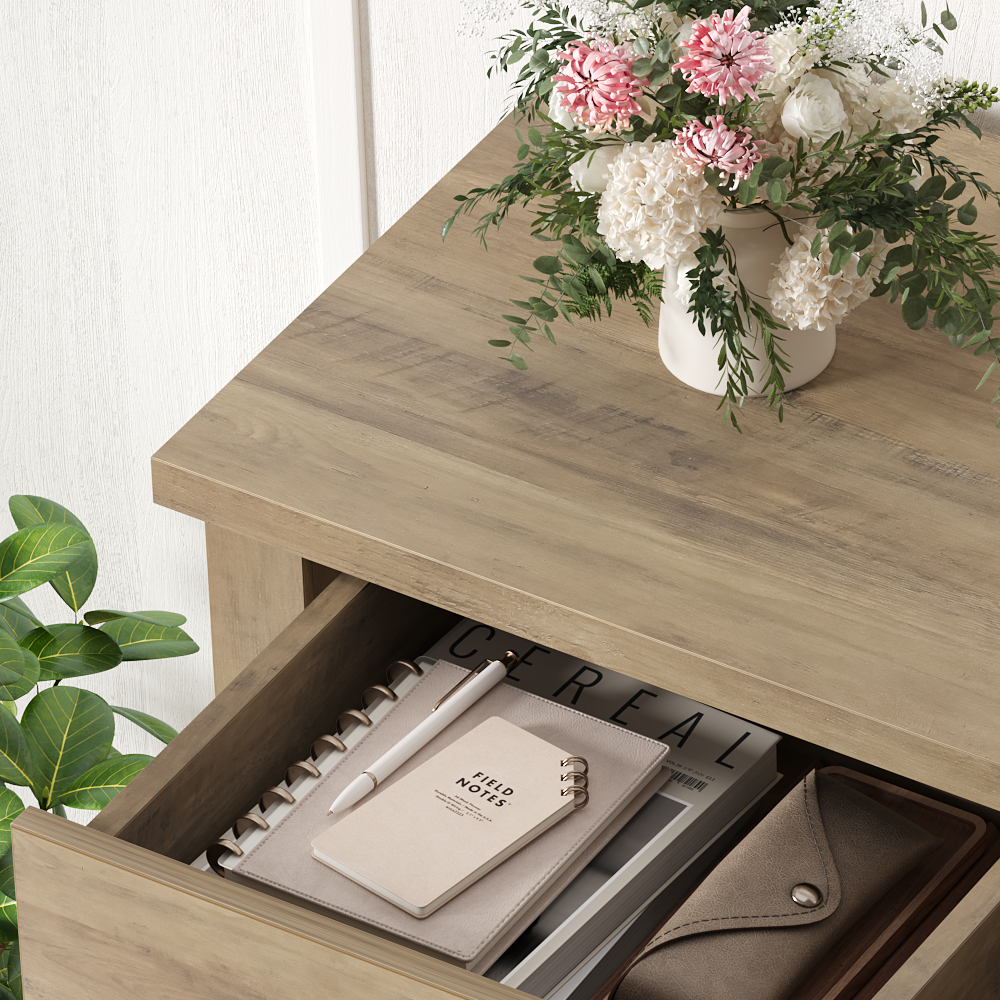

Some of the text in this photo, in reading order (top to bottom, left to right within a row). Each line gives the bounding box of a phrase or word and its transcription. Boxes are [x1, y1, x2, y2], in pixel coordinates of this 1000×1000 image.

[448, 624, 752, 770] CEREAL
[455, 777, 507, 807] NOTES
[472, 772, 514, 796] FIELD
